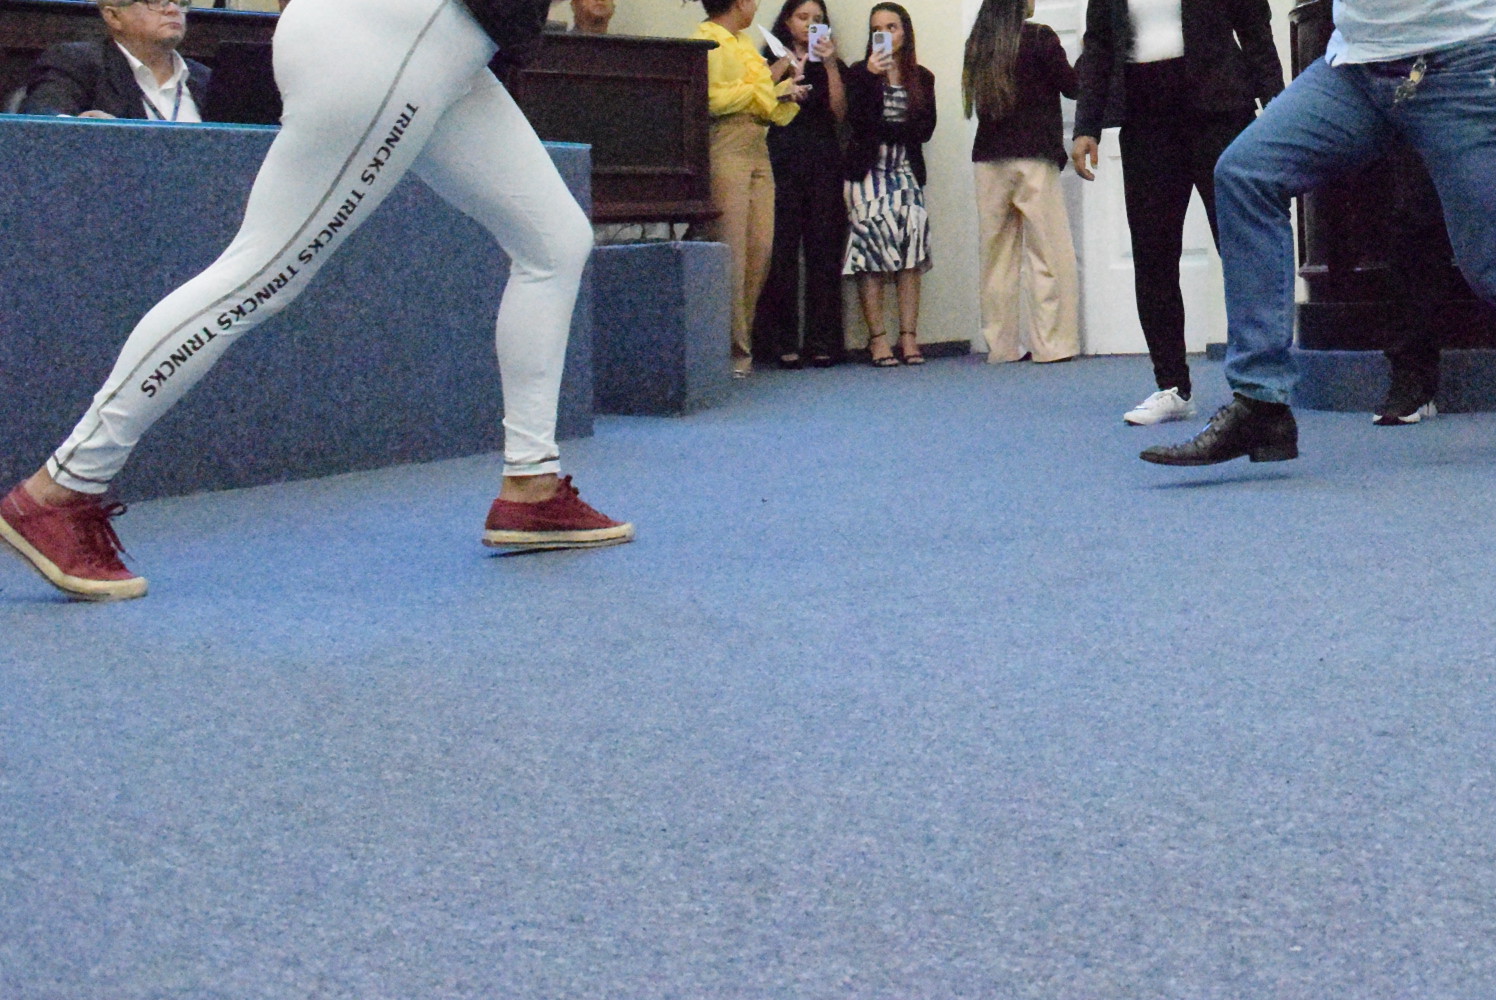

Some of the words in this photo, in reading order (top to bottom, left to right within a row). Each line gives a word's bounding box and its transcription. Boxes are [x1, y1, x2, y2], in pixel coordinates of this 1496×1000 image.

[359, 101, 419, 186] TRINCKS
[297, 189, 366, 265] TRINCKS
[216, 264, 299, 331] TRINCKS
[140, 326, 217, 399] TRINCKS
